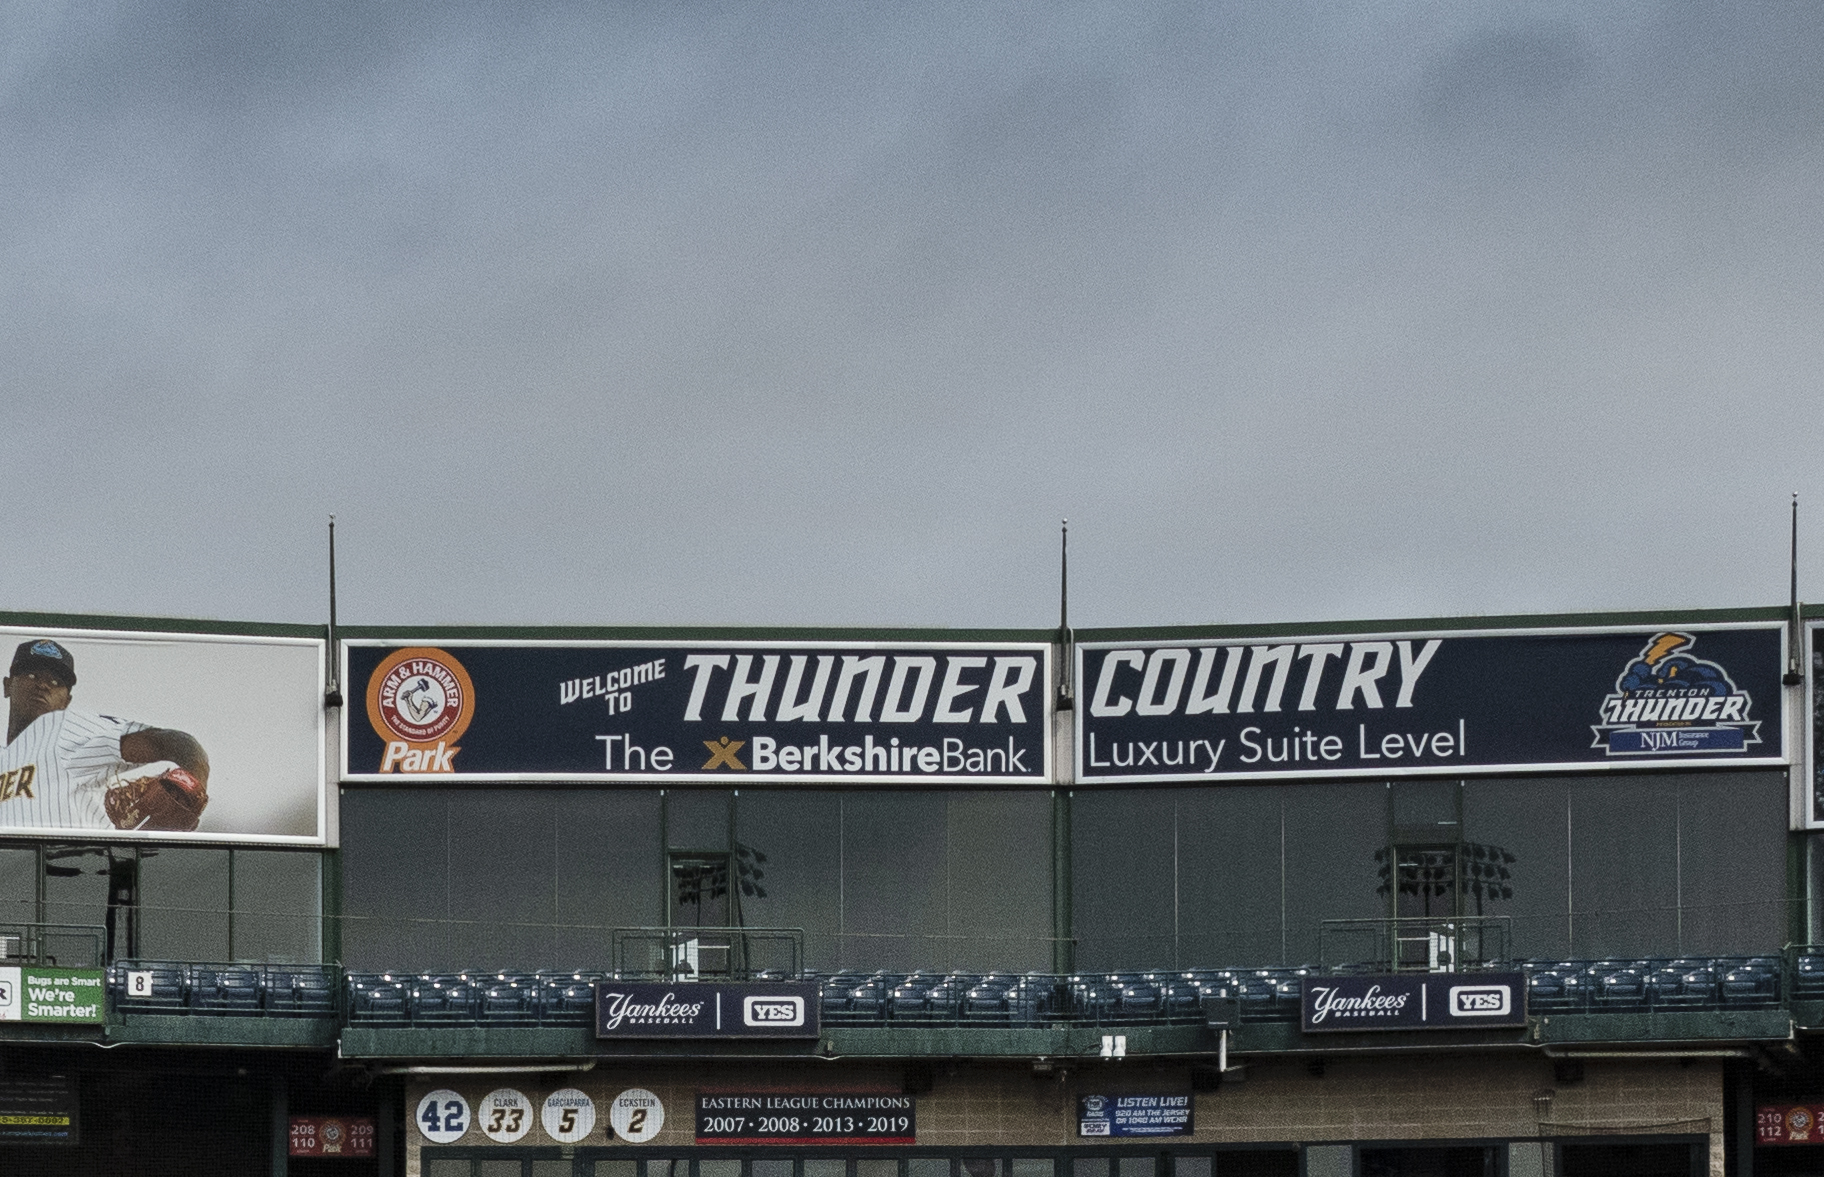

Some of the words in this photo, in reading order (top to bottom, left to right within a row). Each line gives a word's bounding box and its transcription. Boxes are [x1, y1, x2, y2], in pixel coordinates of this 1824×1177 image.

[382, 673, 402, 707] ARM
[398, 666, 411, 679] &
[412, 662, 459, 707] HAMMER
[559, 657, 665, 706] WELCOME
[1090, 639, 1443, 717] COUNTRY
[683, 654, 1037, 723] THUNDER
[1635, 688, 1710, 698] TRENTON
[605, 690, 632, 716] TO
[1607, 696, 1744, 722] THUNDER
[1089, 731, 1226, 773] Luxury
[1239, 726, 1343, 762] Suite
[1359, 718, 1466, 759] Level
[1640, 731, 1679, 751] NJM
[382, 741, 455, 771] Park
[594, 733, 674, 771] The
[27, 975, 51, 988] Bugs
[53, 977, 70, 986] are
[71, 976, 101, 987] Smart
[135, 976, 144, 991] 8
[27, 988, 75, 1003] We're
[1310, 984, 1407, 1024] Yankees
[1459, 993, 1501, 1010] YES
[27, 1002, 97, 1018] Smarter!
[606, 991, 701, 1030] Yankees
[753, 1004, 794, 1021] YES
[1334, 1009, 1400, 1018] BASEBALL
[630, 1016, 695, 1025] BASEBALL
[493, 1098, 518, 1107] CLARK
[619, 1097, 656, 1108] ECKSTEIN
[702, 1097, 763, 1110] EASTERN
[767, 1097, 820, 1110] LEAGUE
[823, 1097, 911, 1110] CHAMPIONS
[1117, 1097, 1157, 1107] LISTEN
[1160, 1096, 1188, 1107] LIVE!
[421, 1100, 464, 1133] 42
[487, 1108, 525, 1133] 33
[558, 1108, 579, 1133] 5
[626, 1109, 648, 1134] 2
[703, 1116, 745, 1134] 2007
[758, 1116, 800, 1134] 2008
[811, 1116, 854, 1134] 2013
[866, 1116, 909, 1134] 2019
[1758, 1113, 1782, 1124] 210
[291, 1124, 315, 1135] 208
[351, 1125, 374, 1135] 209
[1759, 1126, 1781, 1136] 112
[292, 1138, 315, 1148] 110
[350, 1138, 373, 1148] 111
